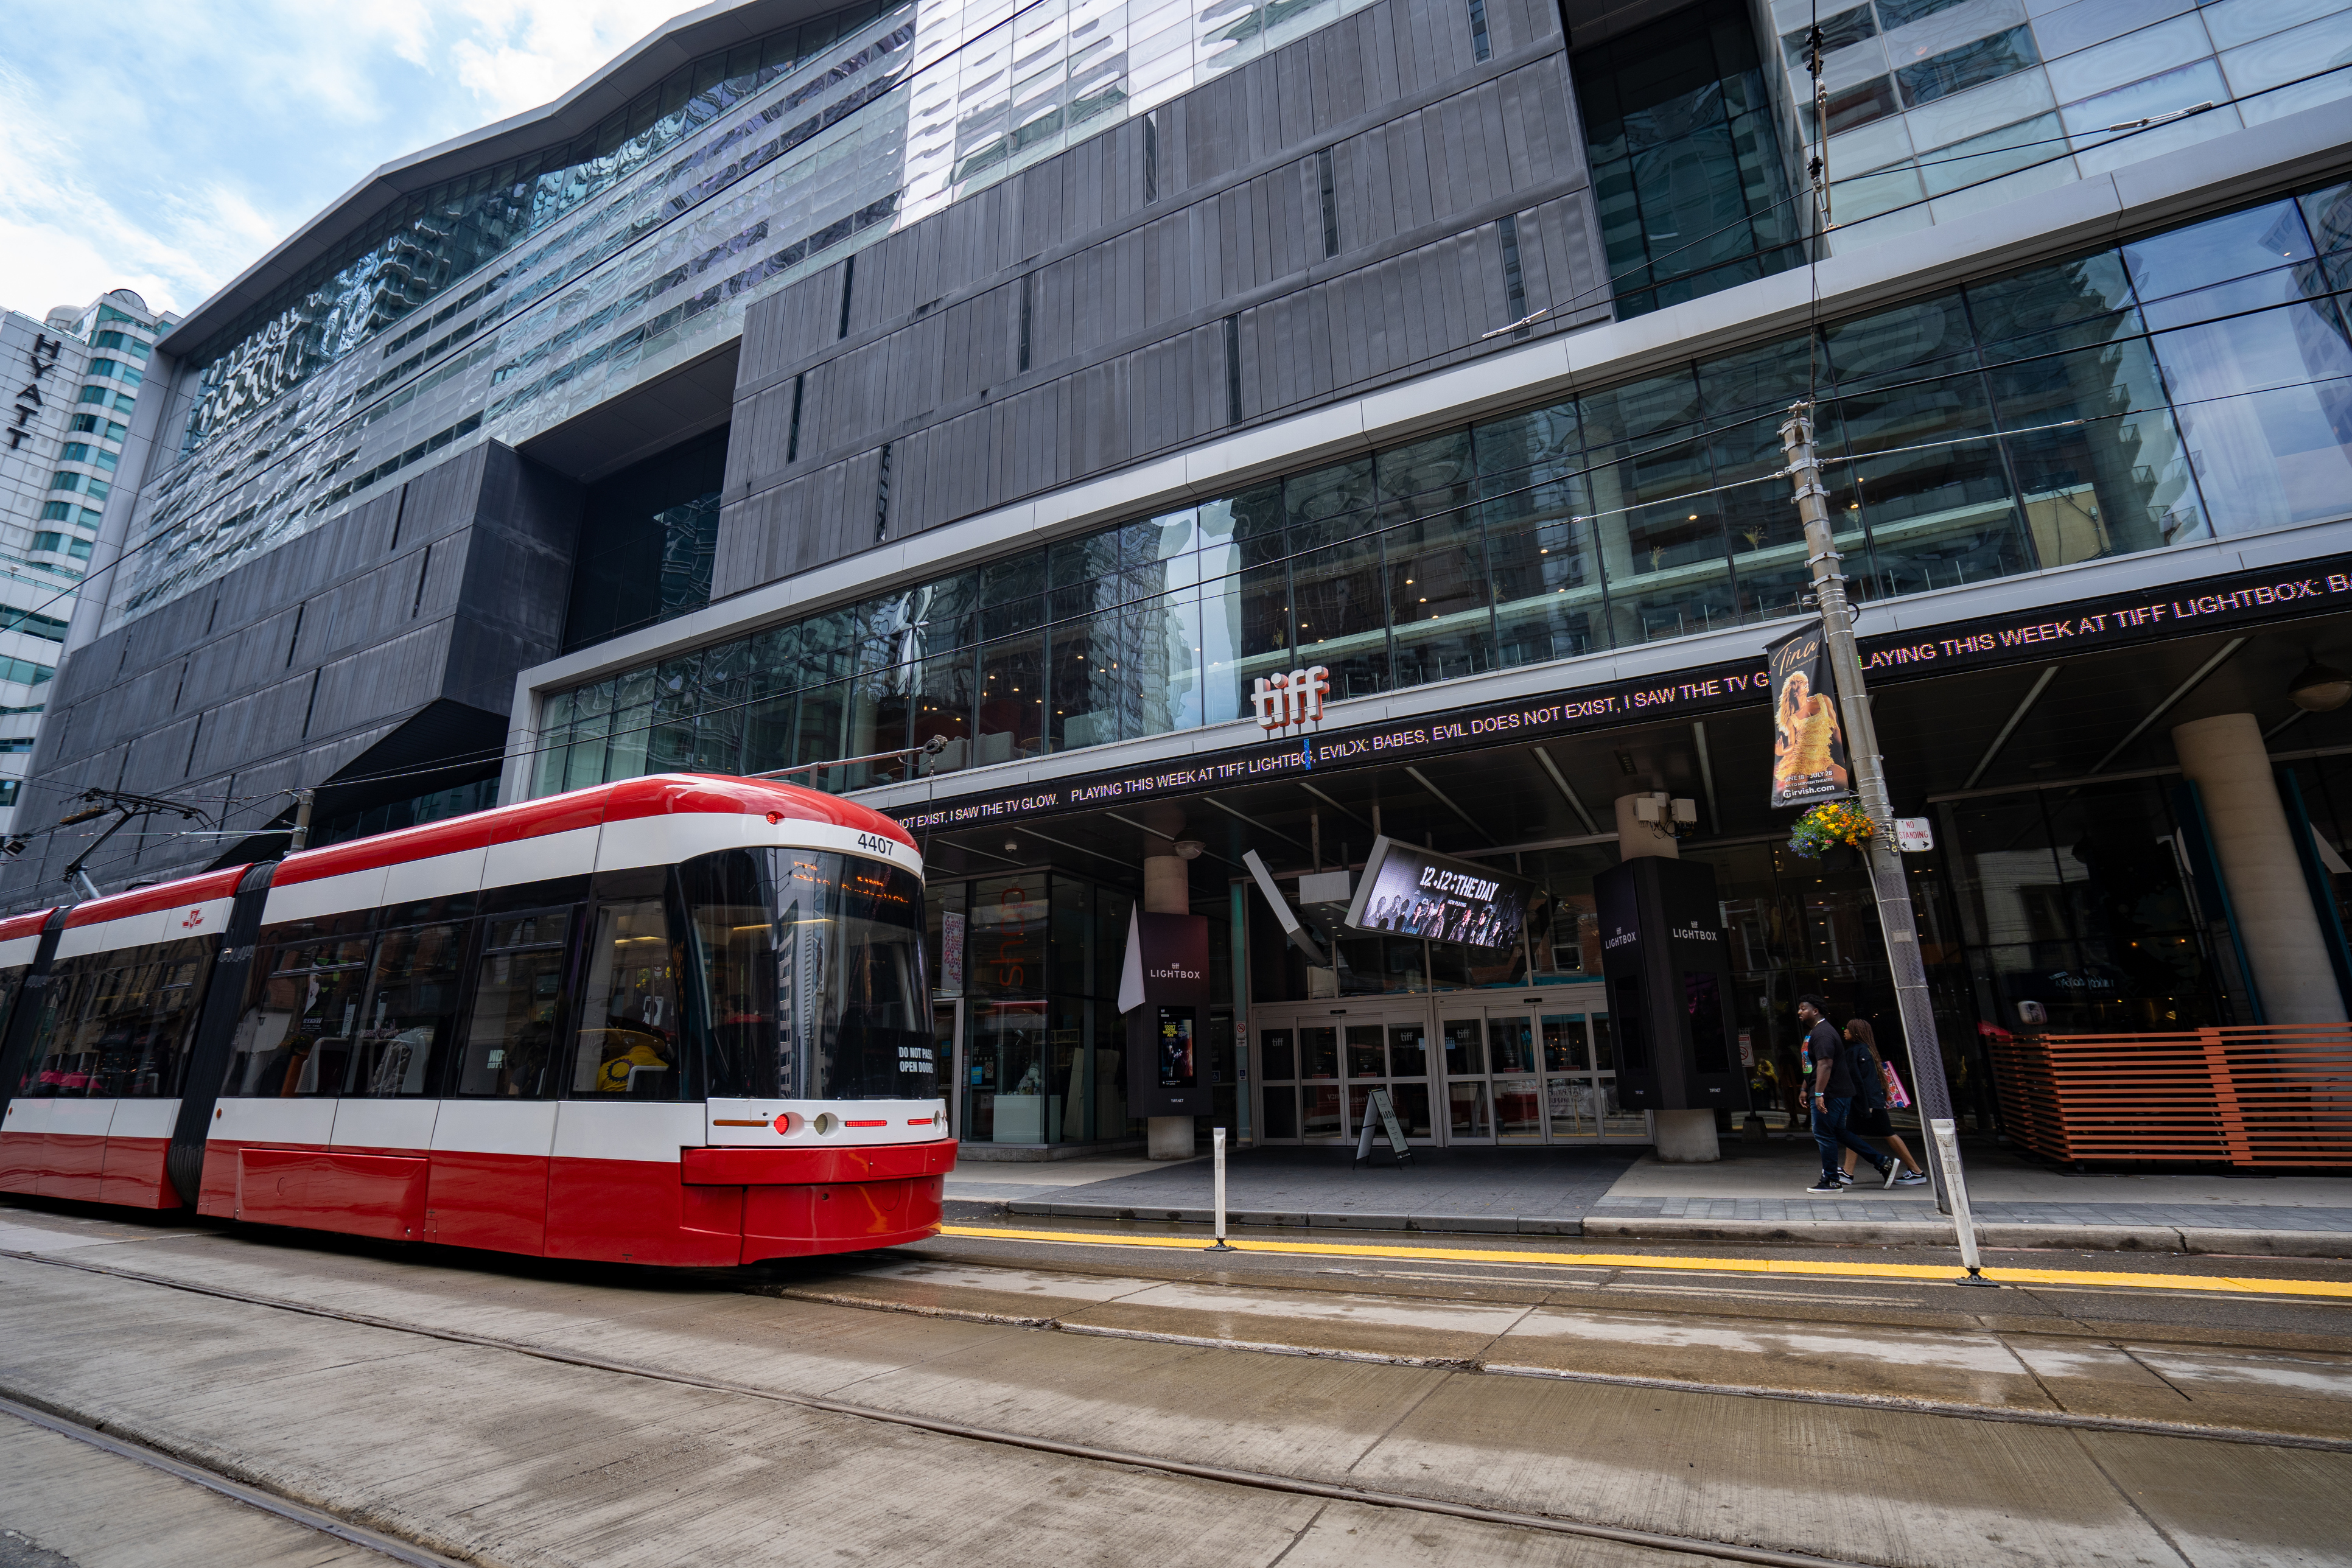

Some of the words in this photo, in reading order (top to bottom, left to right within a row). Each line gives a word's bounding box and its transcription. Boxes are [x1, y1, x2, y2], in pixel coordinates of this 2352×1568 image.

[7, 333, 62, 449] HYATT
[1858, 643, 1937, 670] LAYING
[1940, 633, 1996, 656] THIS
[1999, 620, 2074, 646] WEEK
[2079, 614, 2107, 634] AT
[2112, 604, 2166, 628] TIFF
[2172, 579, 2323, 619] LIGHTBOX:
[1772, 636, 1822, 677] Tina
[1250, 665, 1330, 730] tiff
[1071, 782, 1122, 802] PLAYING
[1124, 777, 1153, 793] THIS
[1157, 770, 1196, 788] WEEK
[1198, 767, 1214, 782] AT
[1217, 762, 1245, 779] TIFF
[1373, 729, 1429, 751] BABES,
[1432, 723, 1468, 741] EVIL
[1471, 713, 1521, 735] DOES
[1524, 706, 1561, 726] NOT
[1564, 697, 1621, 719] EXIST,
[1623, 695, 1630, 709] I
[1634, 687, 1676, 707] SAW
[1679, 679, 1721, 699] THE
[1723, 674, 1748, 692] TV
[1783, 785, 1835, 799] mirvish.com
[917, 811, 948, 827] EXIST,
[950, 810, 953, 821] I
[956, 806, 978, 821] SAW
[981, 802, 1003, 816] THE
[1006, 799, 1020, 813] TV
[1021, 793, 1059, 810] GLOW.
[1899, 830, 1929, 839] STANDING
[857, 833, 894, 856] 4407
[990, 887, 1034, 987] shop
[1606, 931, 1636, 950] LIGHTBOX
[1673, 928, 1718, 941] LIGHTBOX
[1150, 969, 1200, 979] LIGHTBOX
[1401, 1032, 1413, 1041] tiff
[1457, 1029, 1470, 1038] tiff
[1272, 1037, 1284, 1047] tiff
[898, 1046, 909, 1058] DO
[909, 1047, 922, 1059] NOT
[922, 1048, 933, 1060] PASS
[899, 1060, 918, 1073] OPEN
[918, 1062, 933, 1074] DOORS
[1380, 1110, 1396, 1120] ARDA
